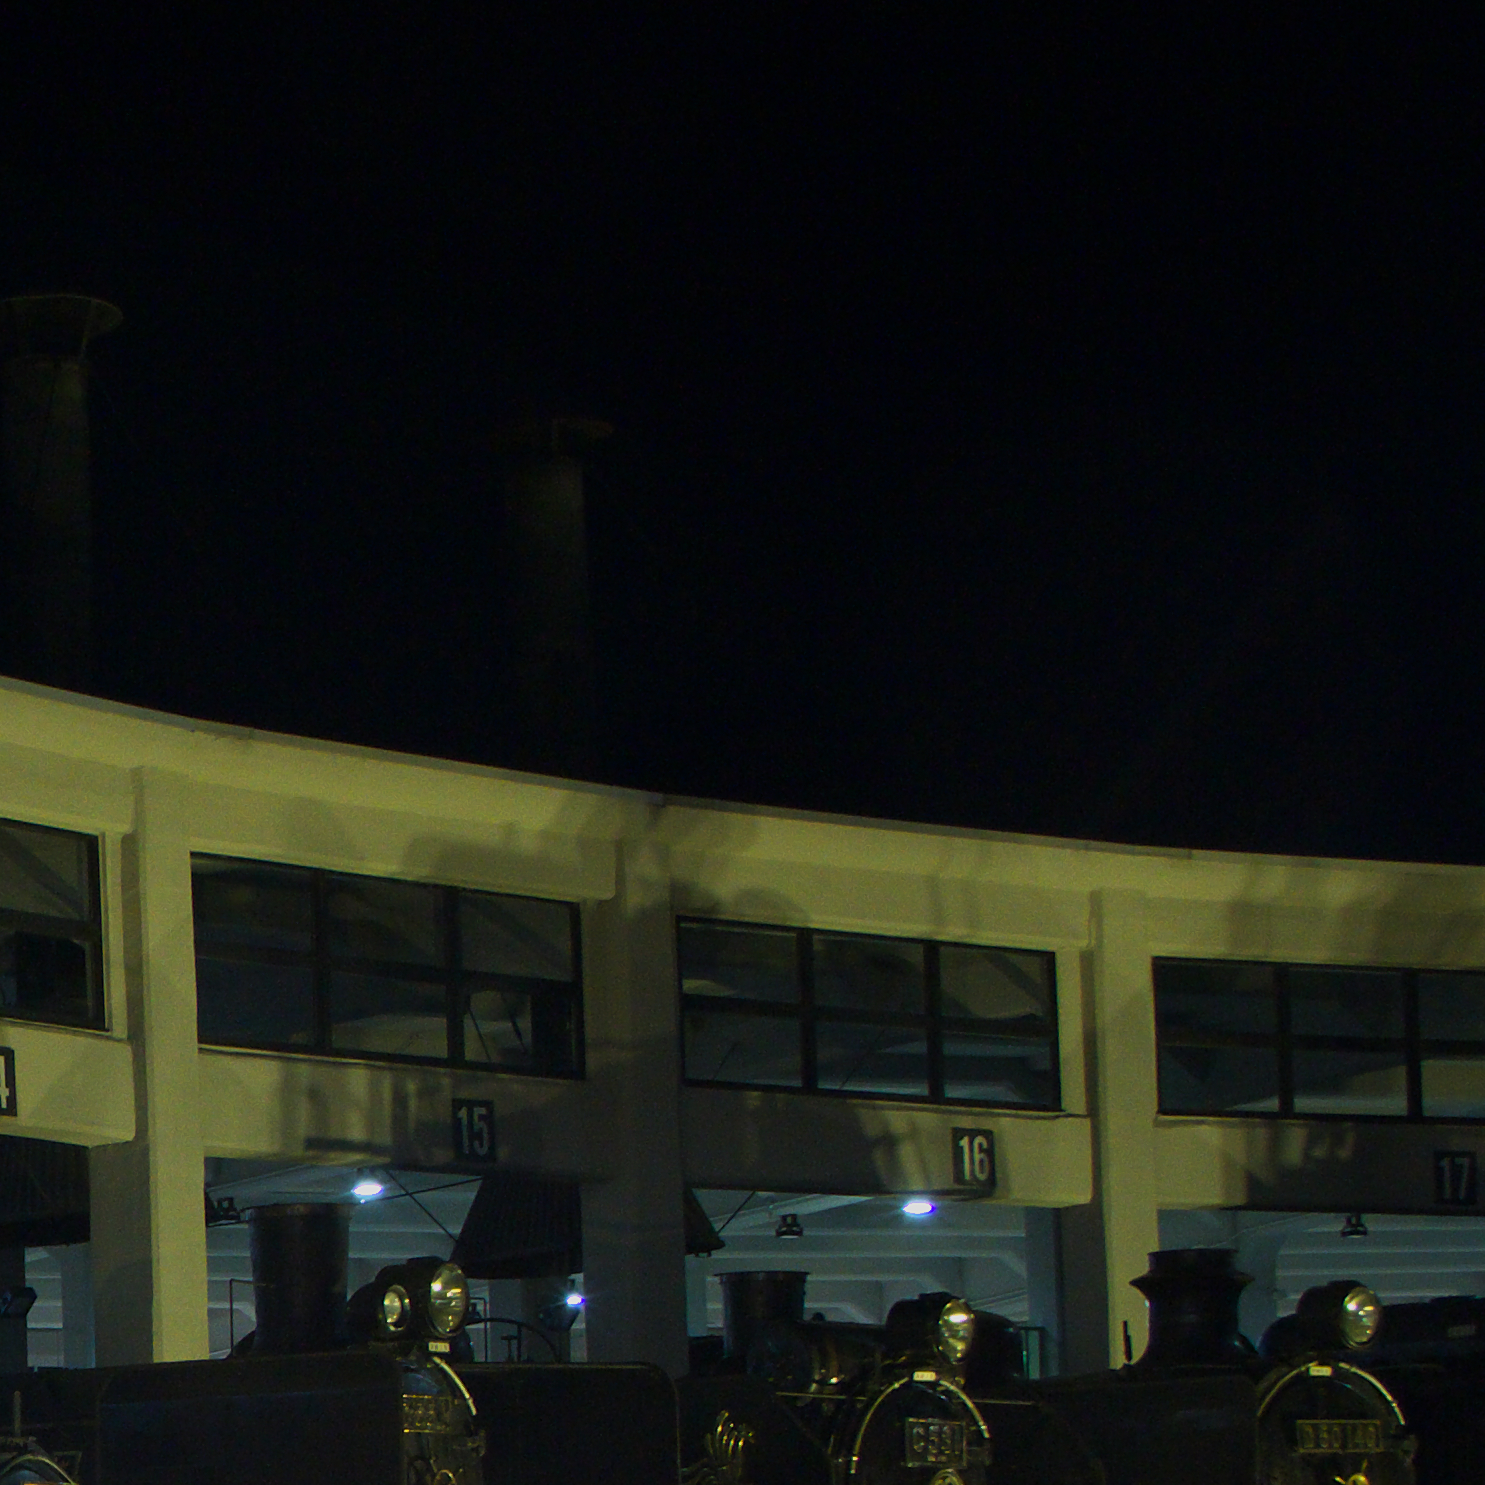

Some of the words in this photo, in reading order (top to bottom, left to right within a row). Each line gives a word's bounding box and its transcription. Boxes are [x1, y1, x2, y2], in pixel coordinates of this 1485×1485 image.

[457, 1106, 489, 1157] 15
[958, 1134, 990, 1181] 16
[1438, 1156, 1471, 1200] 17
